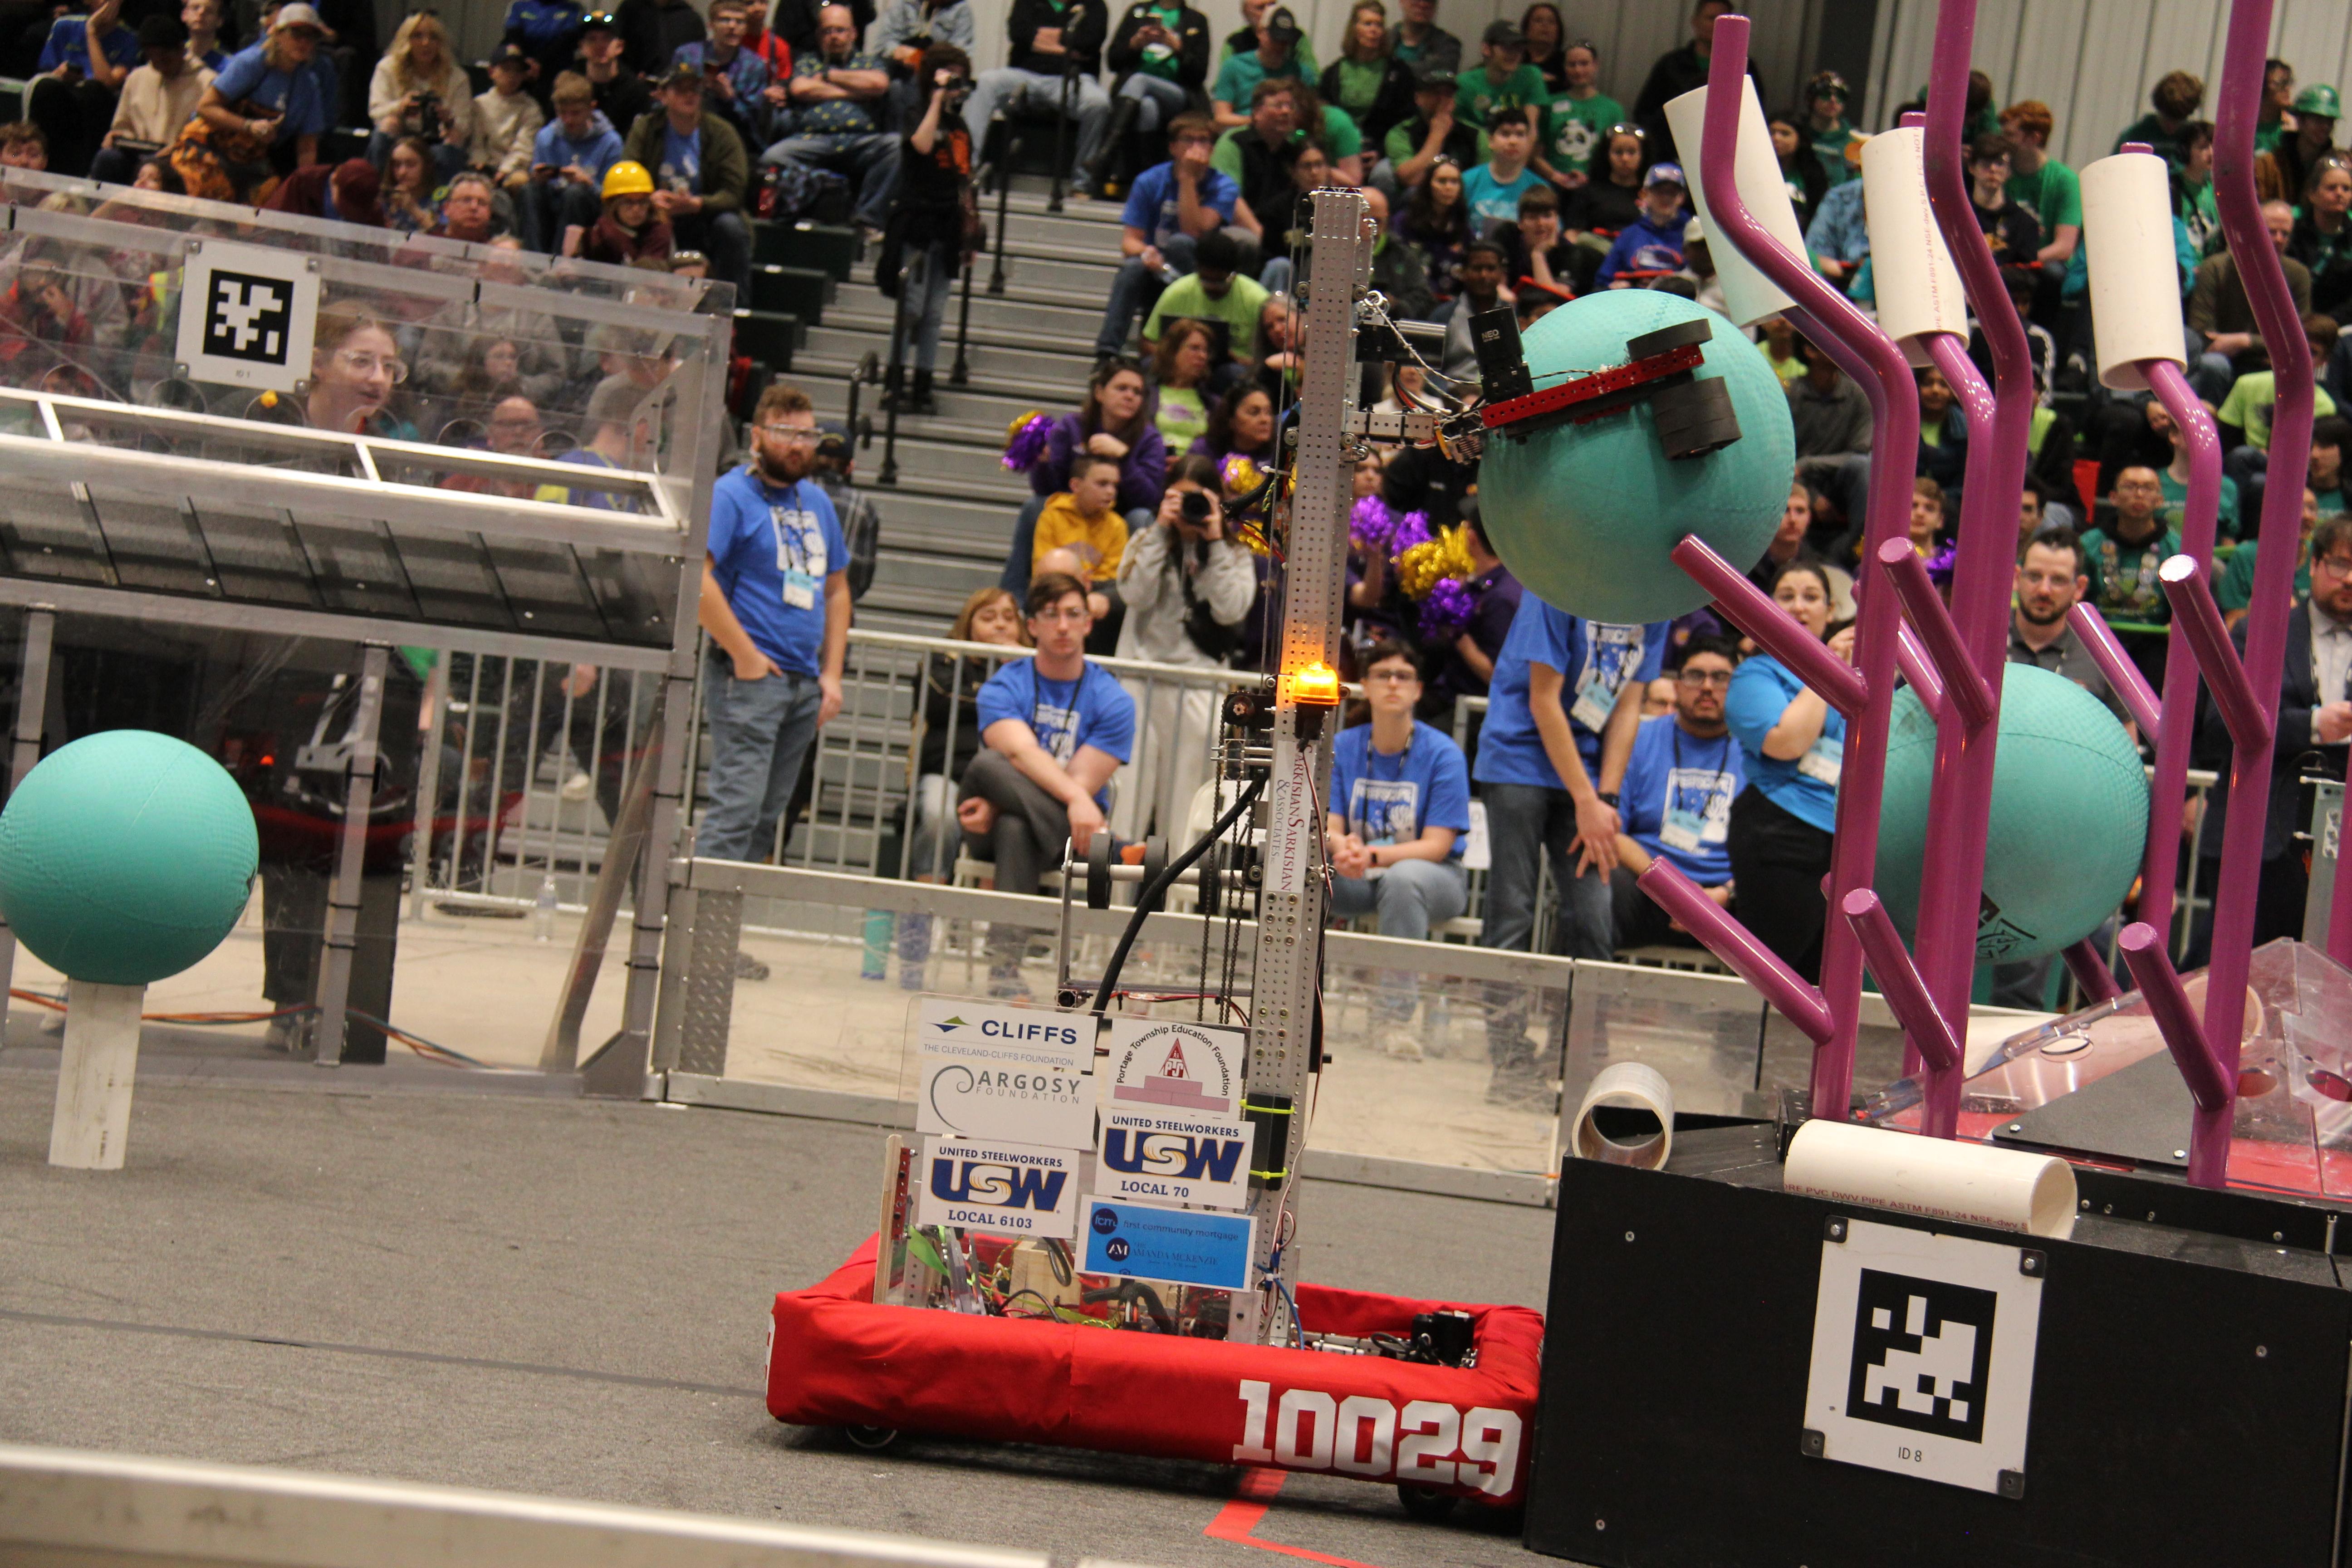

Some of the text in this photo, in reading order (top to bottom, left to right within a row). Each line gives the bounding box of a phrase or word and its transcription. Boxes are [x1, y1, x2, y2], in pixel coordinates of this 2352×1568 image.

[1931, 286, 1940, 313] ASTM
[1481, 329, 1499, 339] NEO
[981, 1019, 1077, 1044] CLIFFS
[924, 1044, 1073, 1066] THE CLEVELAND-CLIFFS FOUNDATION
[1117, 1024, 1230, 1096] Portage Township Education Foundation
[977, 1071, 1081, 1094] ARGOSY
[976, 1086, 1079, 1104] FOUNDATION
[1112, 1116, 1239, 1137] UNITED STEELWORKERS
[939, 1147, 1063, 1167] UNITED STEELWORKERS
[1103, 1127, 1245, 1184] USW
[931, 1158, 1069, 1212] USW
[1121, 1181, 1189, 1198] LOCAL 70
[1806, 1187, 1828, 1196] PVC
[1832, 1191, 1859, 1201] DWV
[1862, 1196, 1886, 1205] PIPE
[1890, 1201, 1922, 1213] ASTM
[1925, 1207, 1967, 1219] F891-24
[948, 1210, 1033, 1228] LOCAL 6103
[1124, 1220, 1239, 1241] first community mortgage
[1108, 1244, 1128, 1255] AM
[1132, 1248, 1218, 1265] AMANDA MCKENZIE
[1233, 1378, 1523, 1497] 10029
[1898, 1446, 1922, 1462] ID 8
